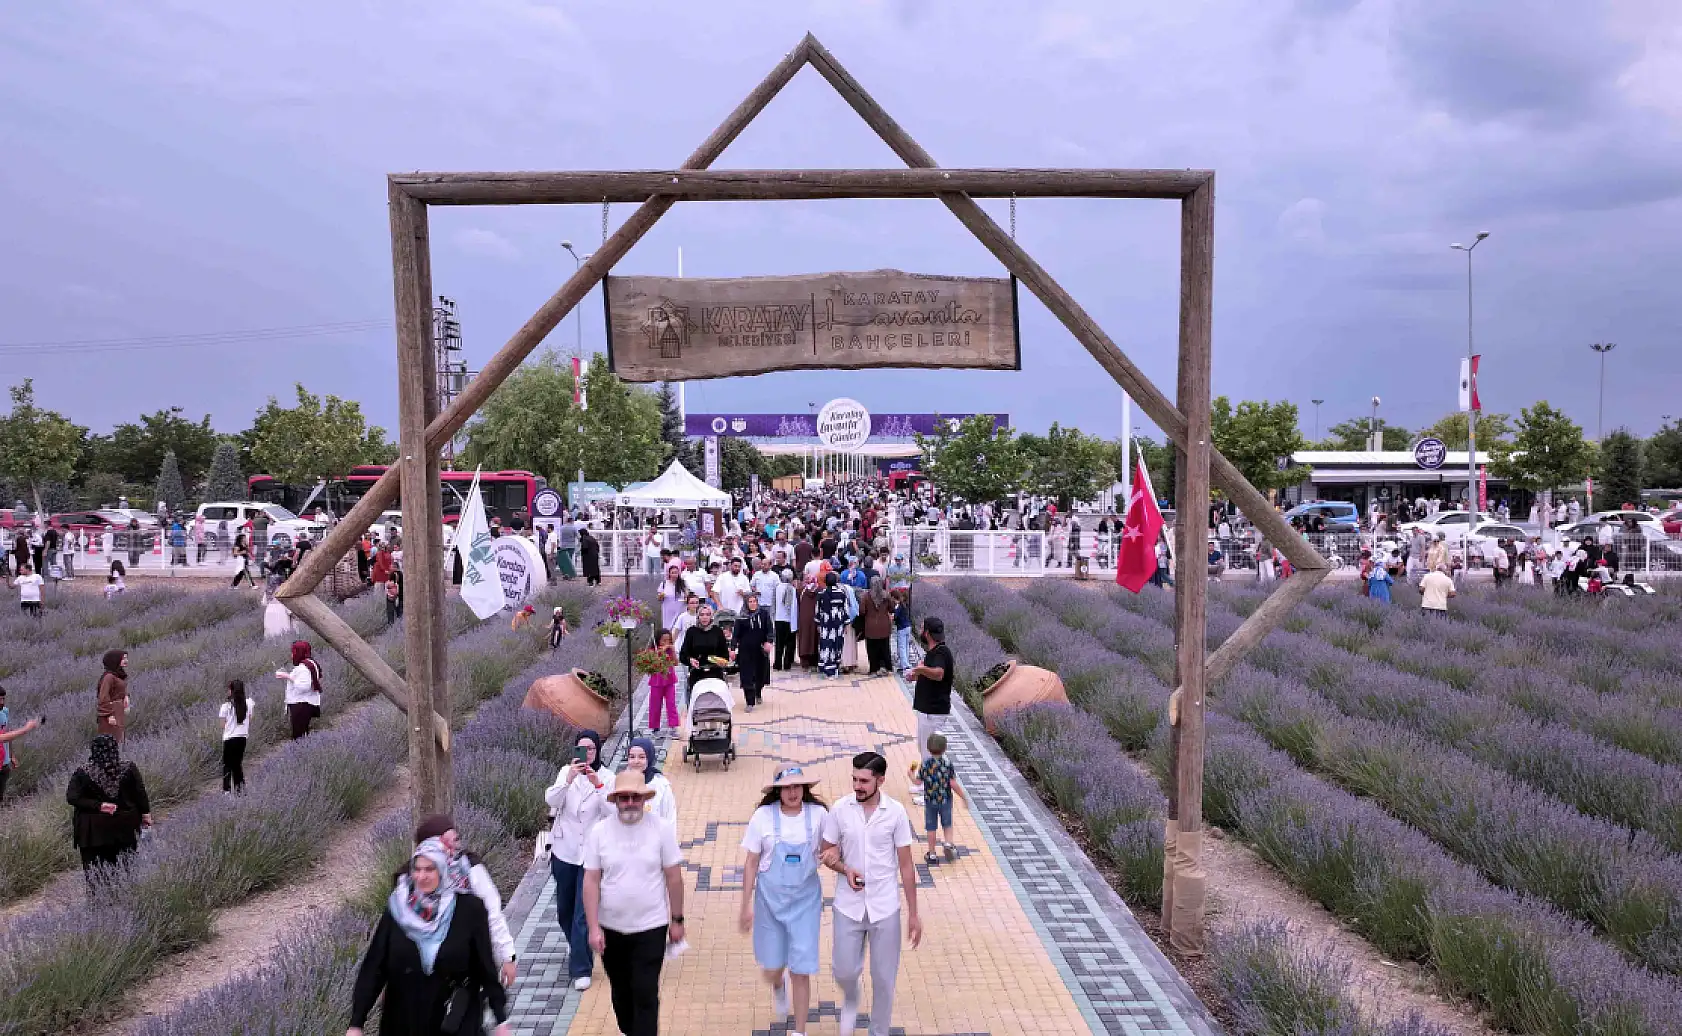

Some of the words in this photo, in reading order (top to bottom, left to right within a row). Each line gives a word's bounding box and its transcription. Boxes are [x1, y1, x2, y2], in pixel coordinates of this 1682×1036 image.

[843, 289, 940, 306] KARATAY
[701, 304, 810, 335] KARATAY
[816, 298, 983, 332] Lavanta
[718, 331, 797, 347] BELEDİYESİ
[831, 330, 971, 351] BAHÇELERİ
